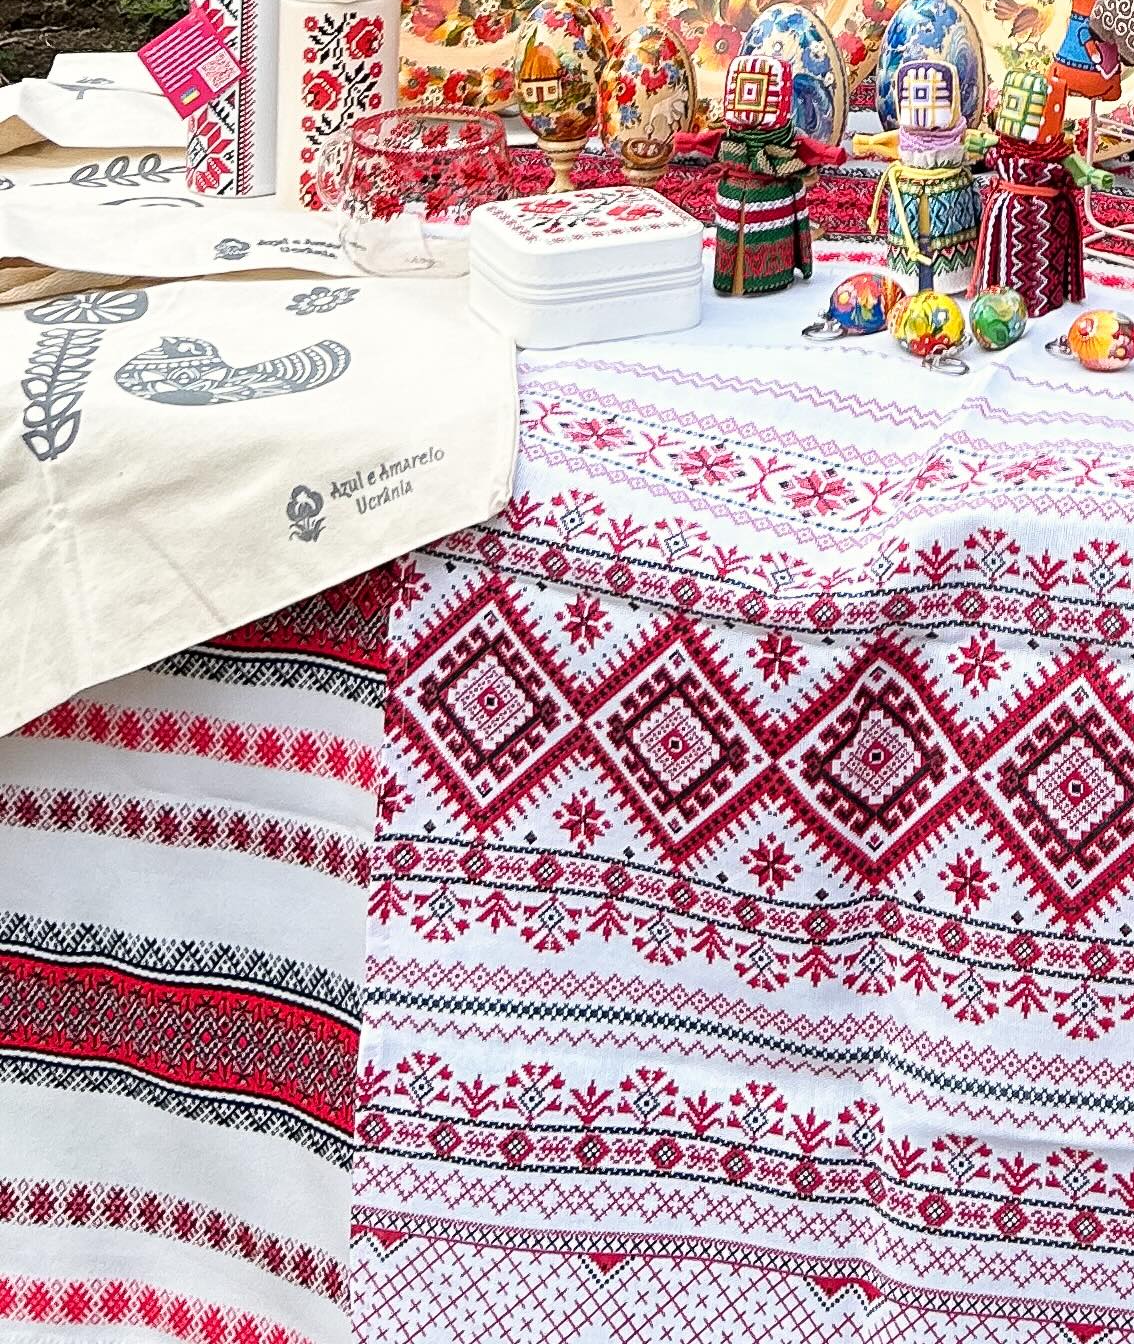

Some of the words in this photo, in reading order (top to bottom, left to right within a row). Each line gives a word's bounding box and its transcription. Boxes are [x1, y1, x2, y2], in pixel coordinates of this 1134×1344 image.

[330, 470, 364, 500] Azul
[367, 470, 377, 486] e
[379, 446, 445, 482] Amarelo
